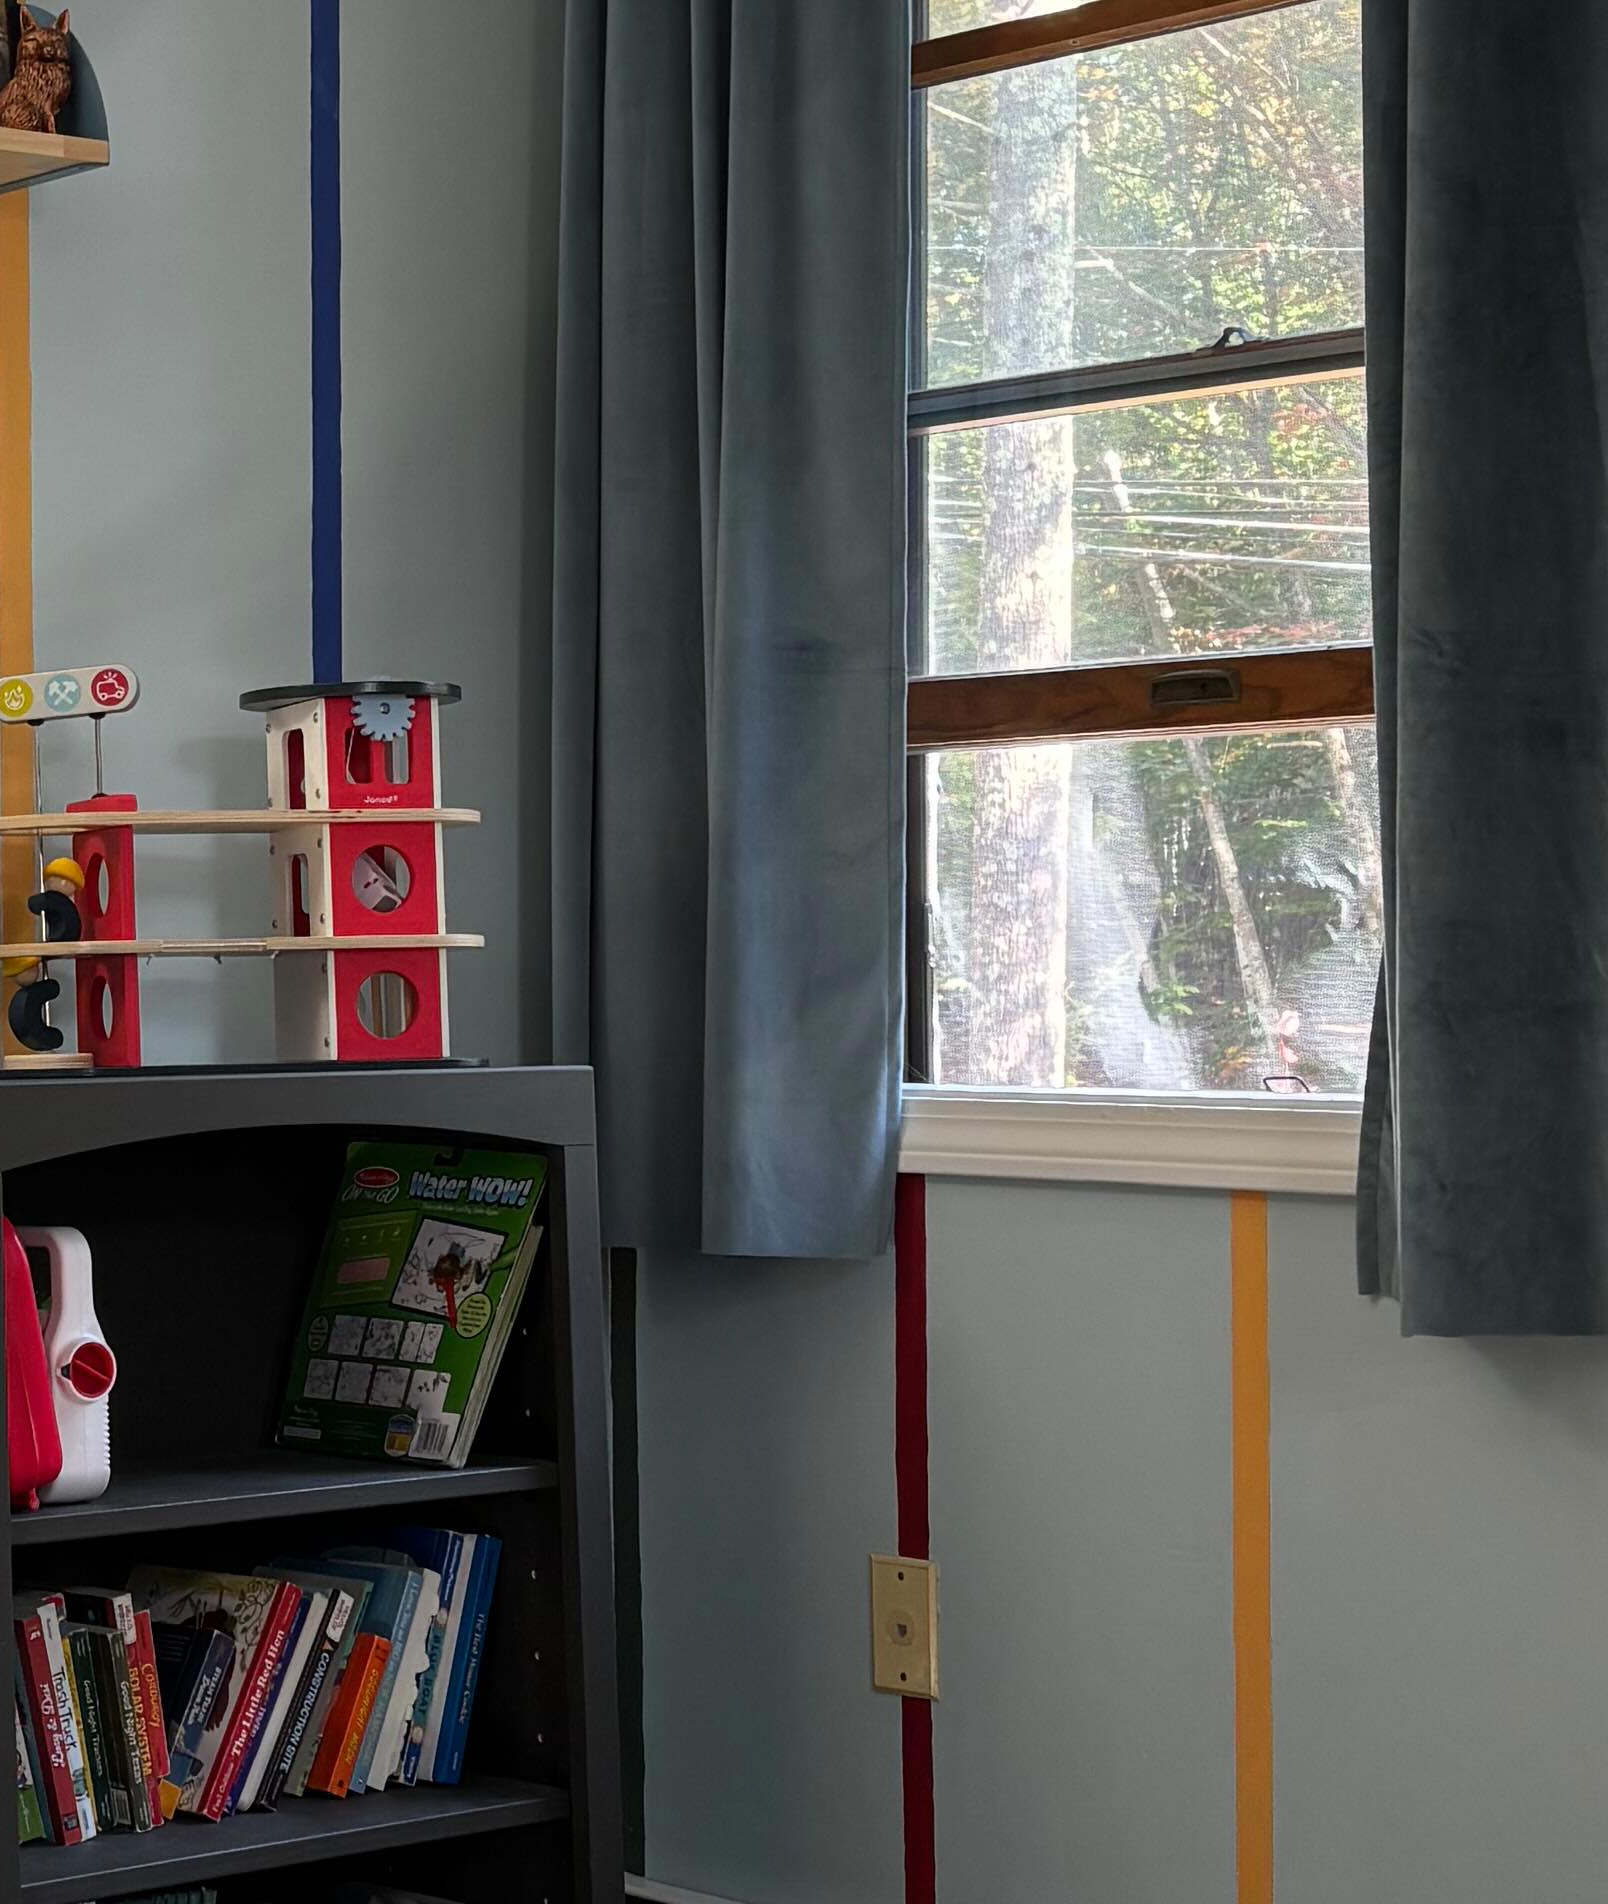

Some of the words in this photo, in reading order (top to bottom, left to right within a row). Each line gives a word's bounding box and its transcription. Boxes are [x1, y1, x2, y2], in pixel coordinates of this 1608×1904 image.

[409, 1170, 467, 1203] Water
[466, 1176, 534, 1208] WOW!
[266, 1628, 287, 1658] Hen
[52, 1667, 72, 1710] Trash
[254, 1657, 276, 1689] Red
[119, 1680, 131, 1710] Good
[239, 1687, 265, 1728] Little
[287, 1651, 332, 1745] CONSTRUCTION
[61, 1711, 78, 1751] Truck
[121, 1712, 137, 1746] Night
[229, 1725, 250, 1758] The
[277, 1743, 297, 1774] SITE
